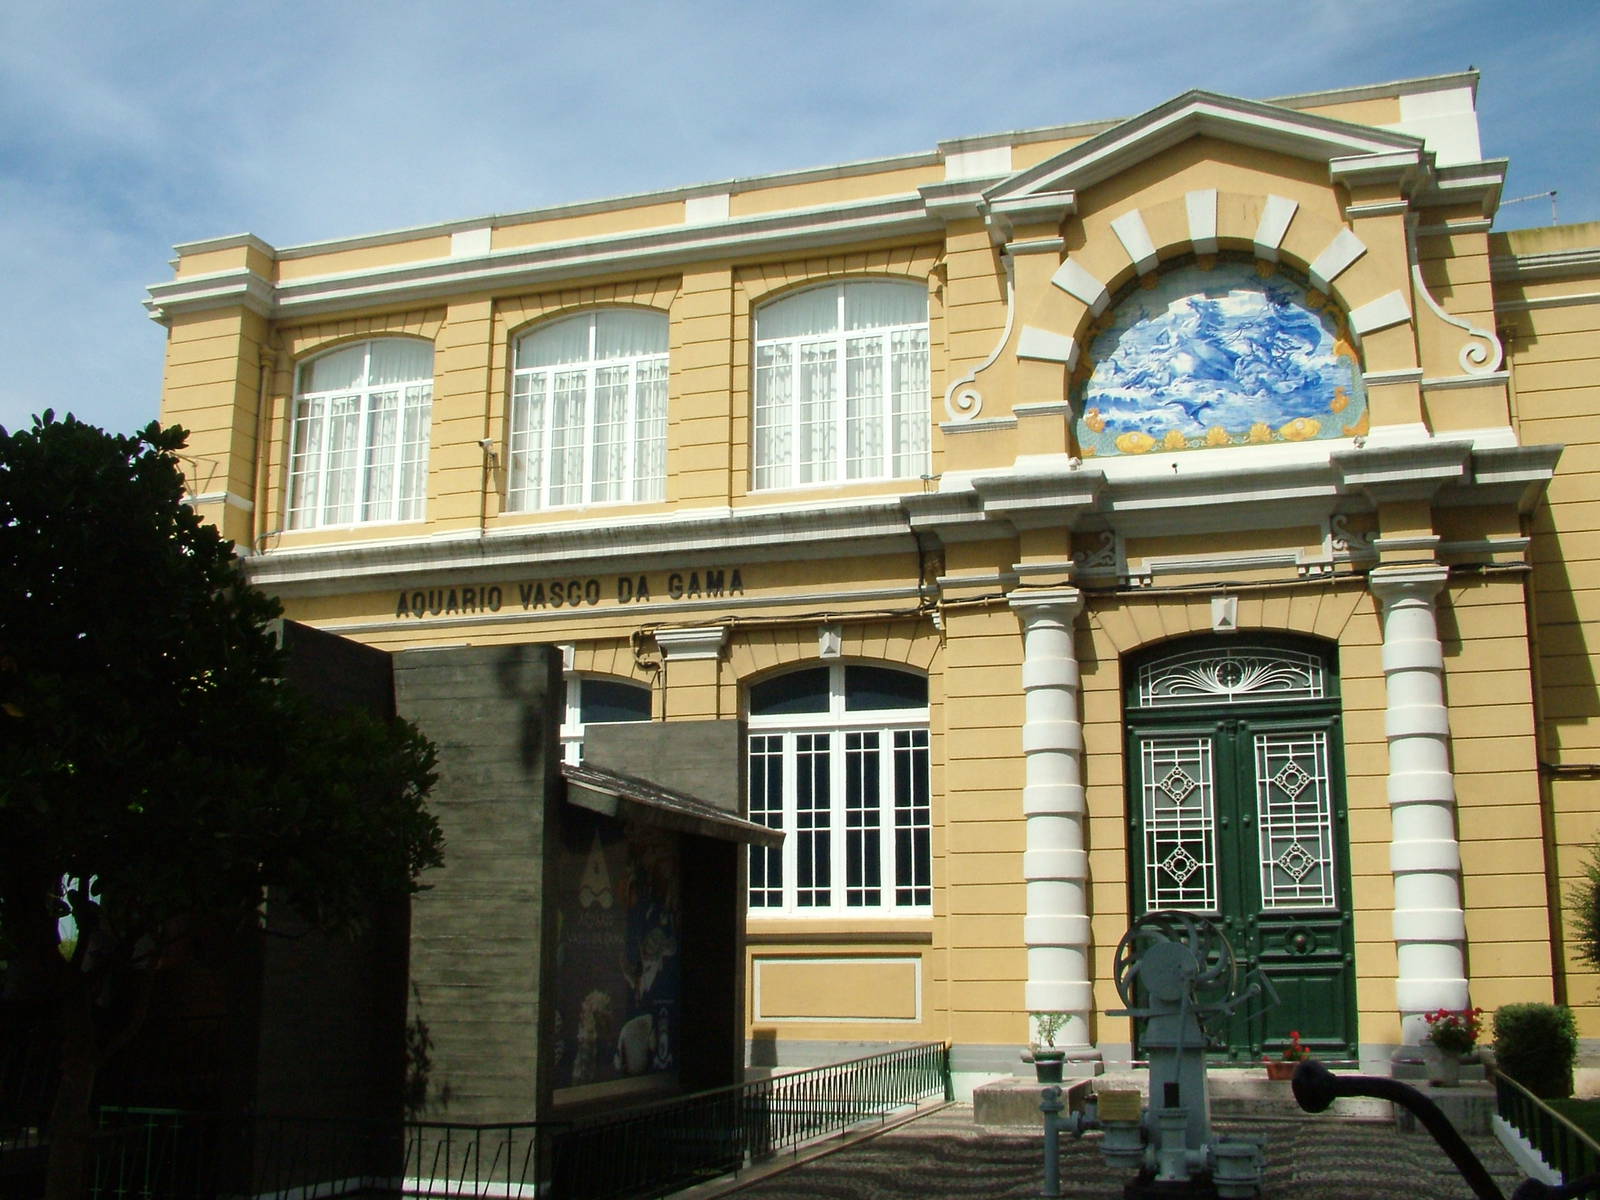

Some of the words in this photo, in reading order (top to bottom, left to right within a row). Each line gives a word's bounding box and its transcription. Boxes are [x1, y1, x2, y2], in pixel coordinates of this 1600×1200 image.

[396, 586, 503, 619] AQUARIO
[519, 579, 601, 610] VASCO
[617, 575, 650, 605] DA
[668, 569, 745, 600] GAMA
